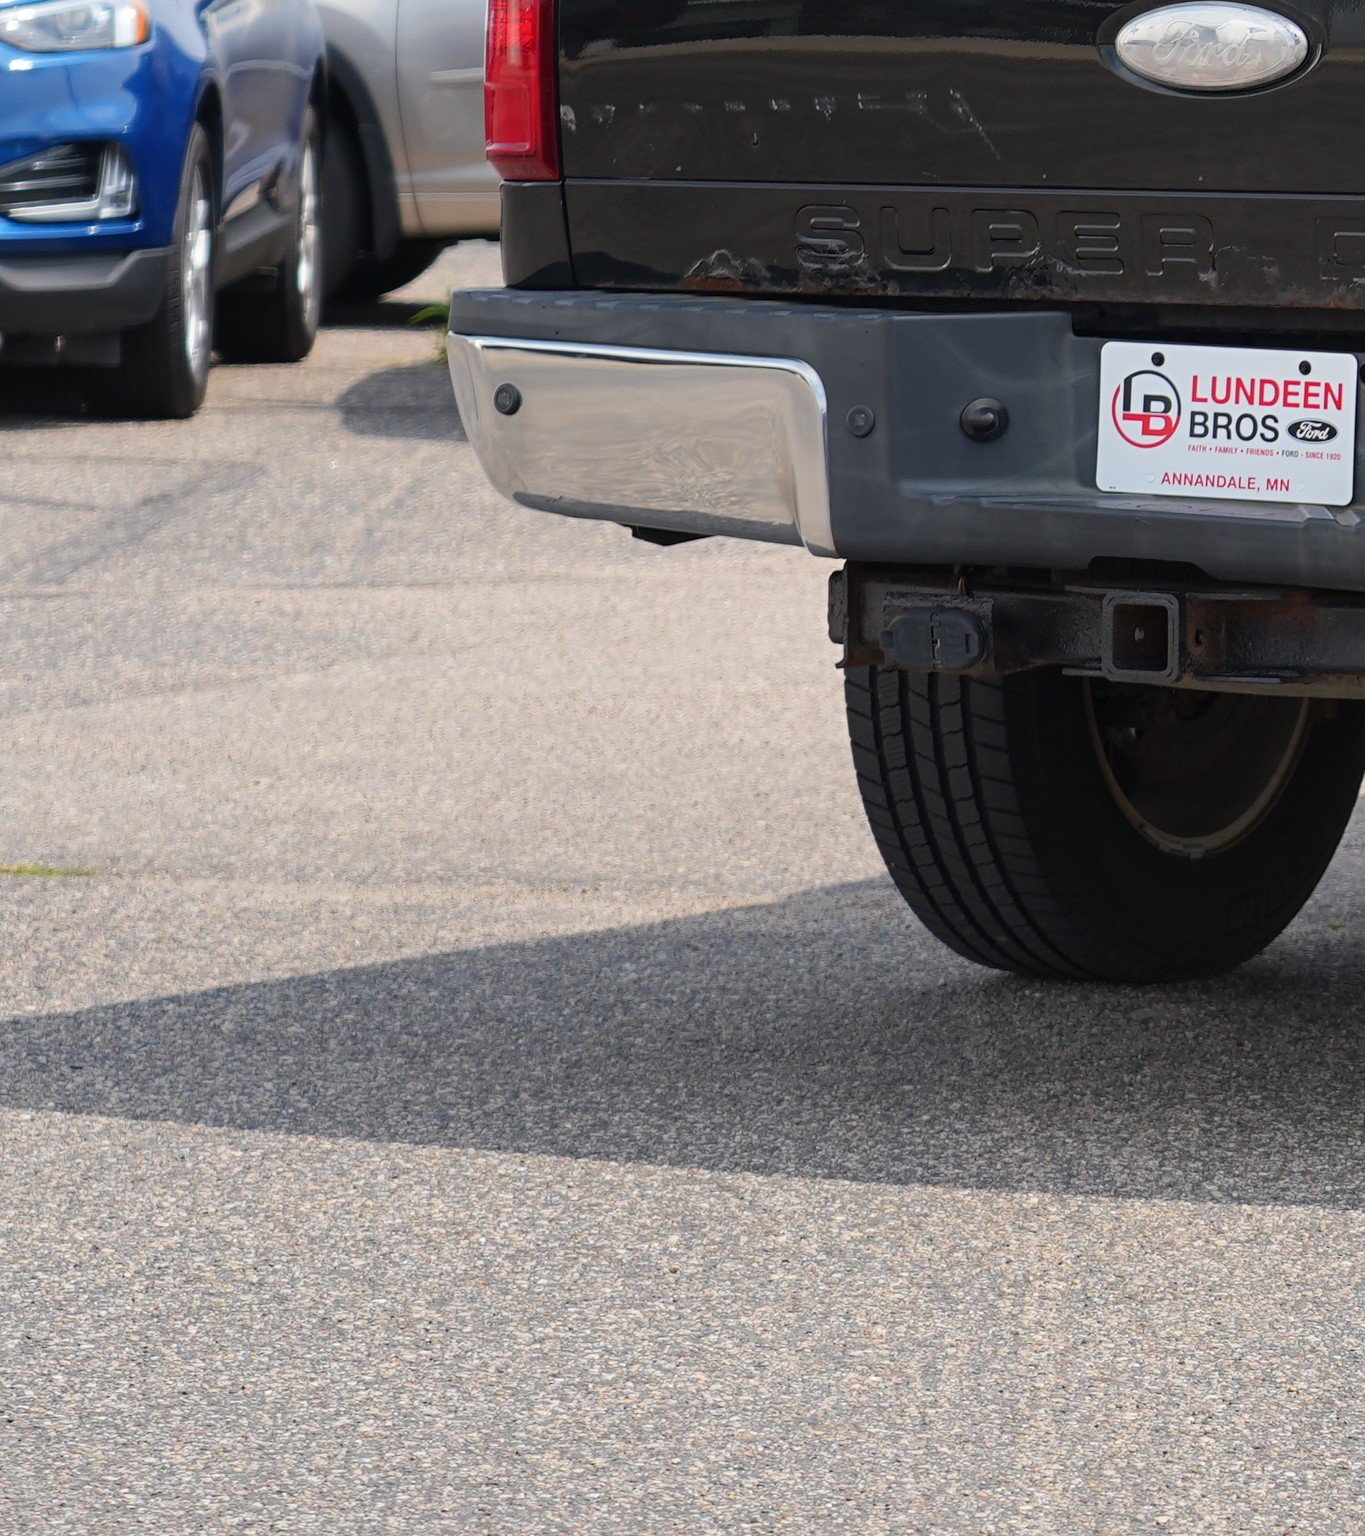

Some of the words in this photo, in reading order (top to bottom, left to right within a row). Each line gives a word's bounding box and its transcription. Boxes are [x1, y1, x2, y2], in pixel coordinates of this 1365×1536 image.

[1152, 19, 1267, 68] Ford
[795, 204, 1217, 280] SUPER
[1191, 375, 1343, 410] LUNDEEN
[1189, 411, 1279, 442] BROS
[1188, 444, 1207, 452] FAITH
[1214, 445, 1238, 454] FAMILY
[1246, 447, 1274, 456] FRIENDS
[1281, 449, 1299, 457] FORD
[1305, 451, 1324, 459] SINCE
[1326, 452, 1341, 460] 1920
[1161, 471, 1261, 492] ANNANDALE,
[1265, 478, 1290, 492] MN
